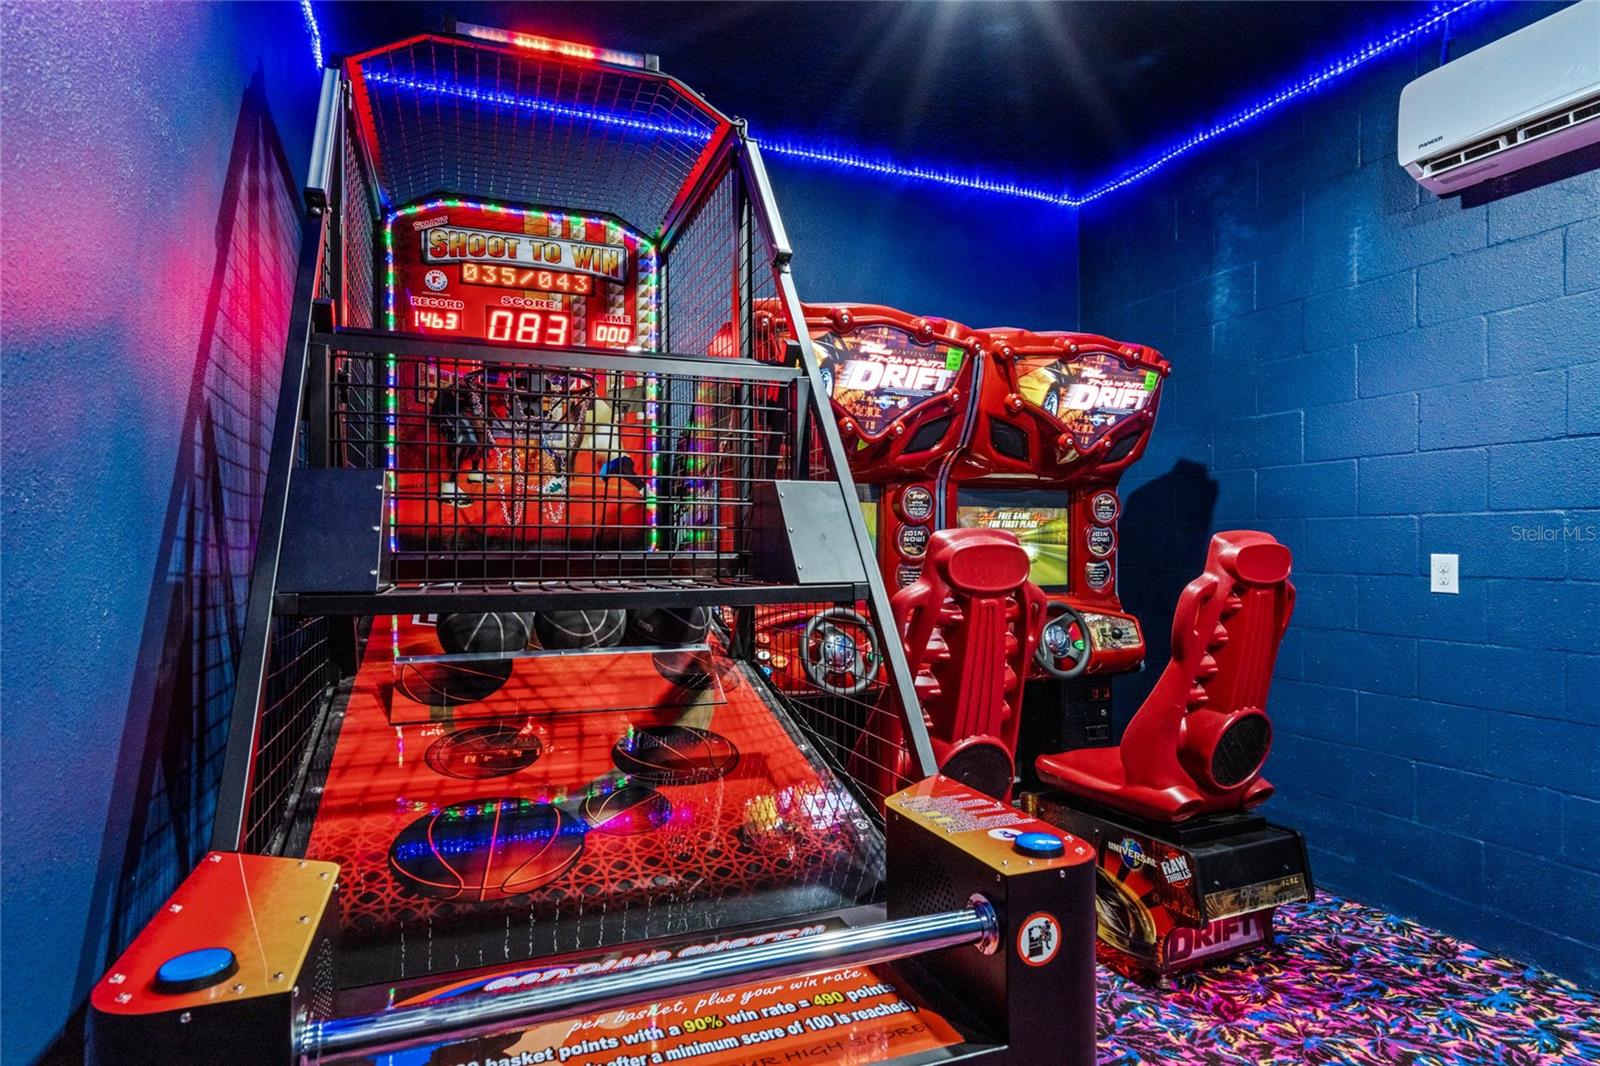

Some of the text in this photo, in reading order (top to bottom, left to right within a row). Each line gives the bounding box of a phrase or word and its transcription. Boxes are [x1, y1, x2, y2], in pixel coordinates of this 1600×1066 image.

[430, 228, 618, 278] SHOOT TO WIN
[463, 263, 588, 292] 035/043
[411, 297, 464, 310] RECORD
[501, 297, 555, 309] SCORE
[414, 310, 458, 330] 1463
[487, 310, 569, 345] 083
[602, 313, 631, 324] IME
[596, 325, 630, 343] 000
[846, 360, 954, 392] DRIFT
[1068, 384, 1150, 410] DRIFT
[1108, 841, 1157, 868] UNIVERSAL
[1161, 855, 1188, 875] RAW
[1165, 869, 1192, 884] THRILLS
[1169, 913, 1257, 962] DRIFT
[566, 970, 868, 1038] per basket, plus your win rate.
[559, 1036, 620, 1061] points
[622, 1027, 665, 1045] with
[668, 1026, 682, 1036] a
[683, 1015, 724, 1033] 90%
[726, 1007, 760, 1025] win
[762, 1001, 798, 1018] rate
[799, 999, 811, 1008] =
[813, 991, 845, 1007] 490
[846, 983, 897, 1003] points
[650, 1051, 664, 1063] a
[665, 1037, 740, 1061] minimum
[741, 1027, 786, 1046] score
[788, 1020, 805, 1036] of
[806, 1014, 836, 1031] 100
[836, 1012, 853, 1026] is
[784, 1042, 844, 1061] HIGH
